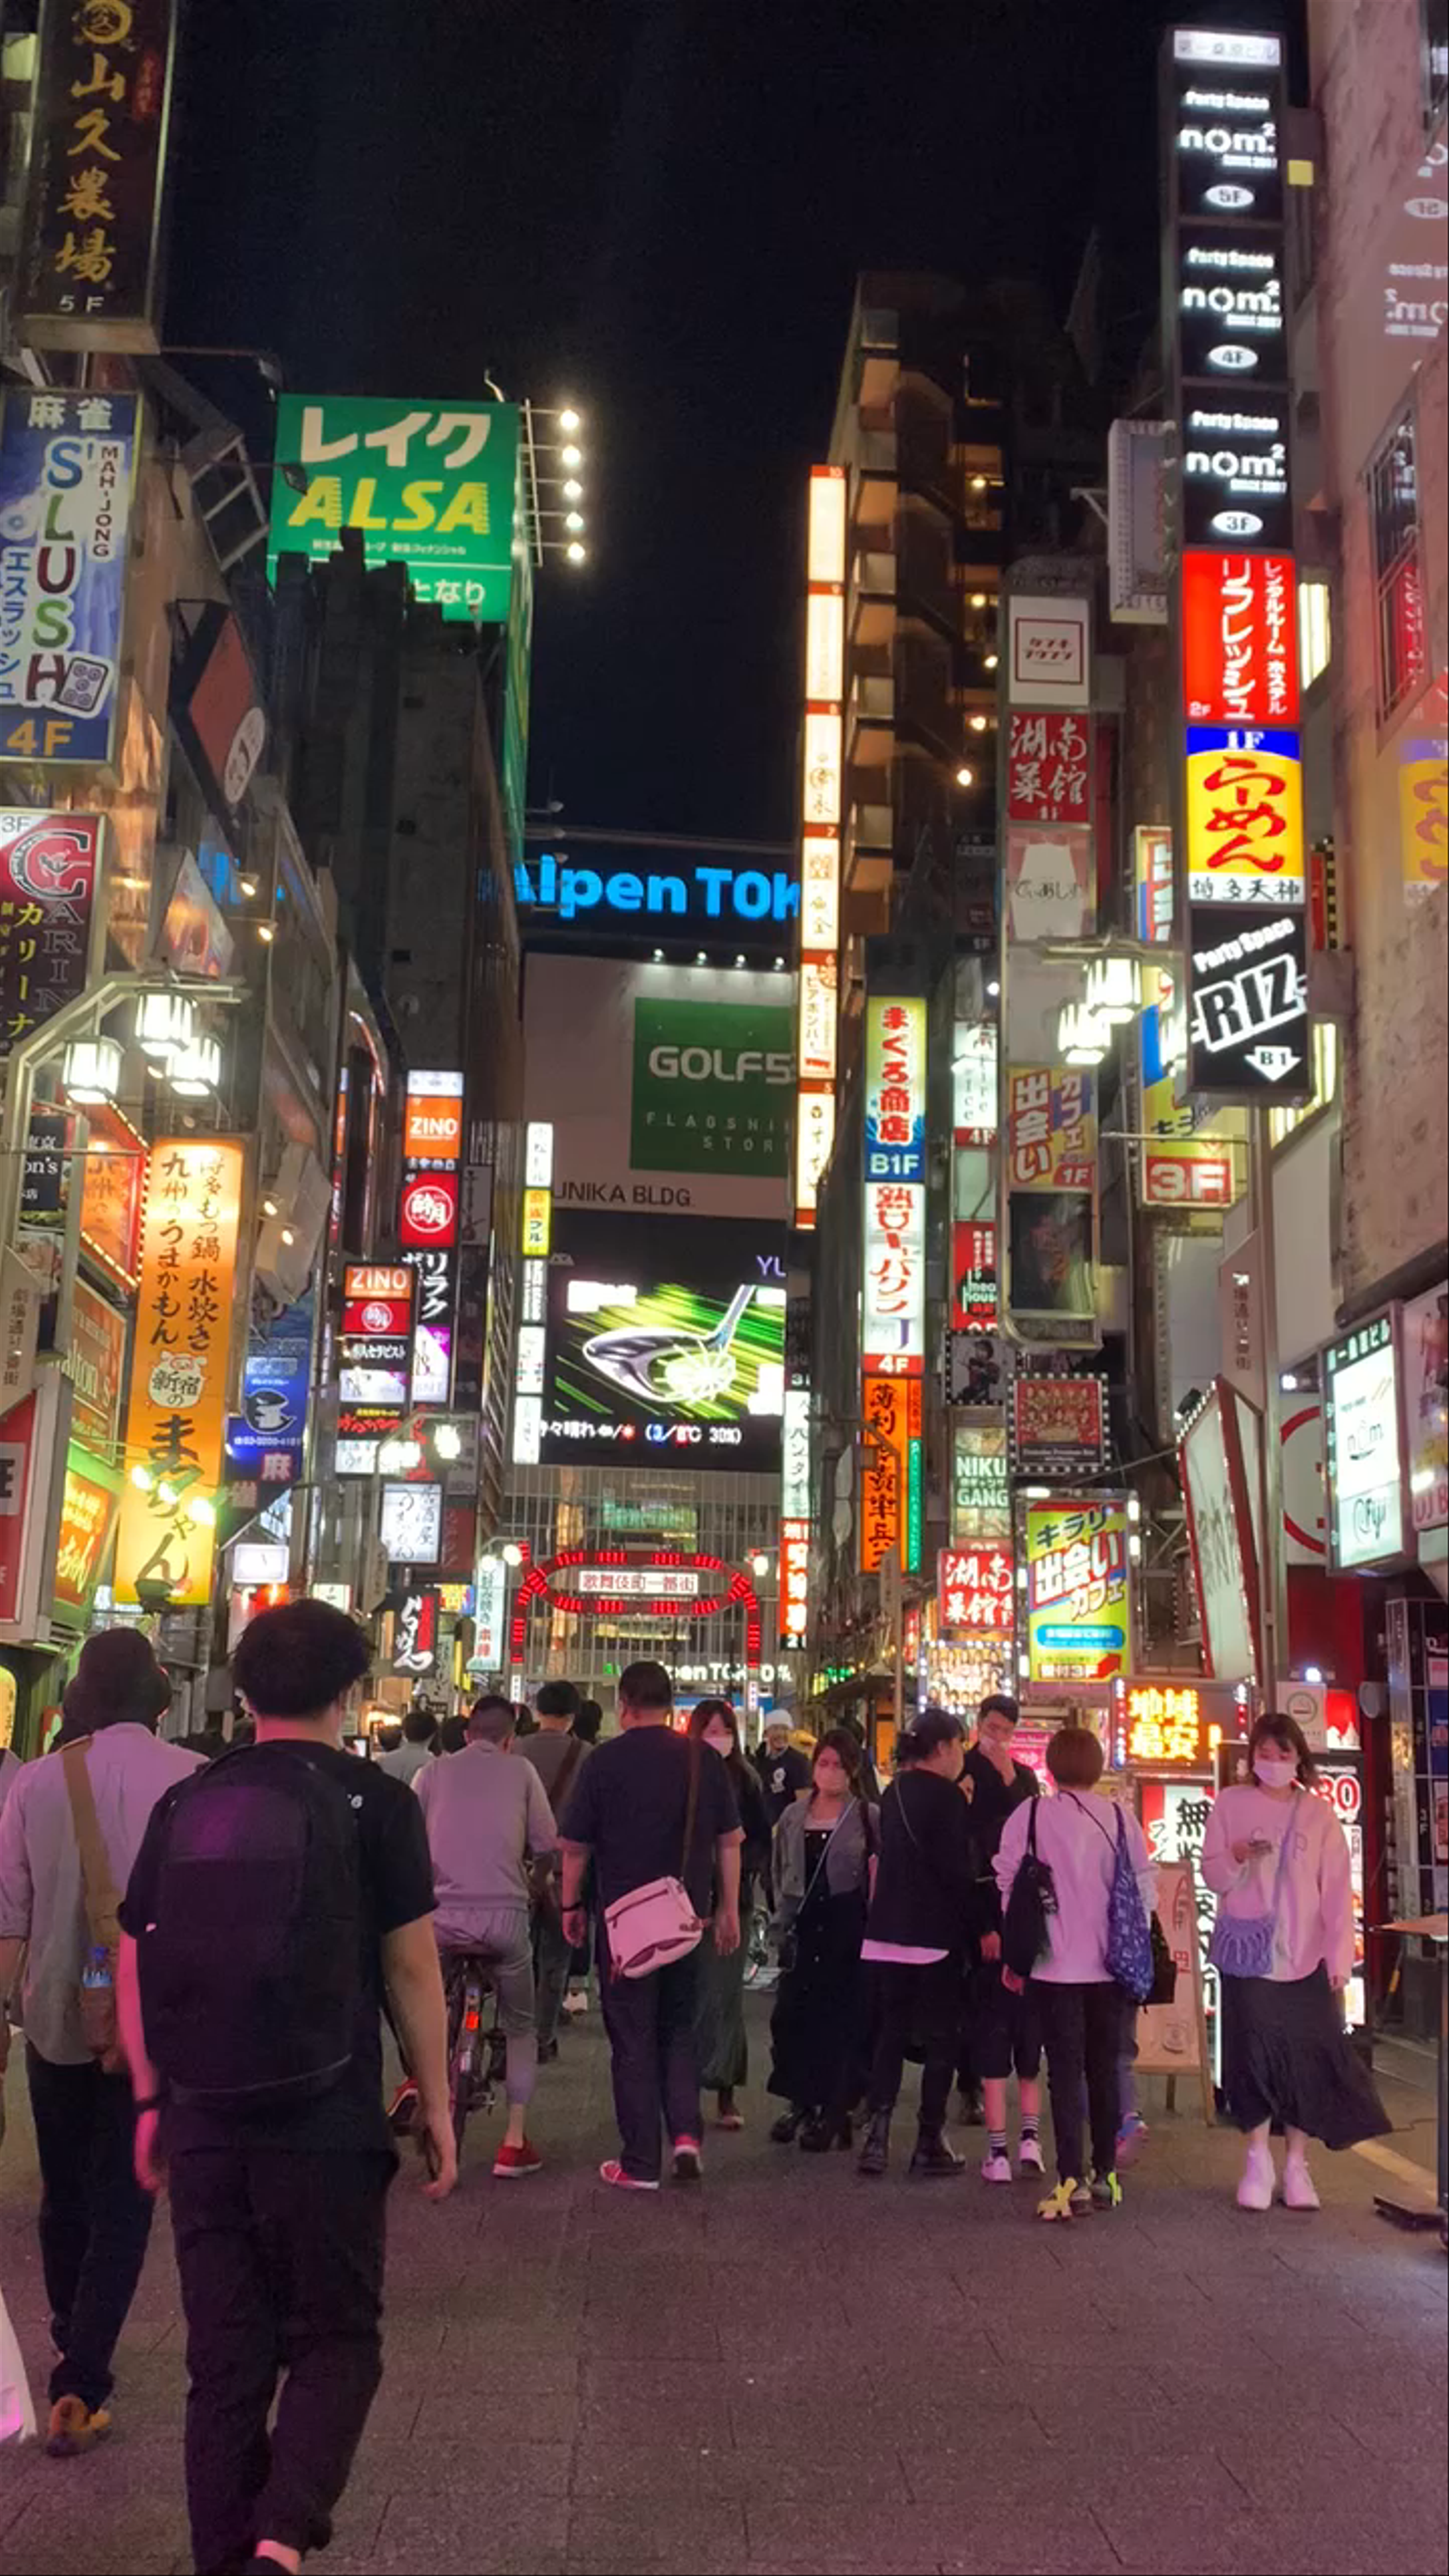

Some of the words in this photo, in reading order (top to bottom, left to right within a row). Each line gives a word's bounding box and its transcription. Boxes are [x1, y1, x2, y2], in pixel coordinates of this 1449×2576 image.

[55, 53, 126, 283] 山久農場
[1220, 190, 1241, 203] 5F
[60, 295, 104, 312] 5F
[1223, 349, 1243, 364] 4F
[28, 396, 113, 431] 麻雀
[300, 407, 491, 469] レイク
[288, 477, 491, 534] ALSA
[1226, 516, 1249, 531] 3F
[1221, 557, 1256, 720] リフレッシュ
[7, 720, 73, 756] 4F
[1010, 716, 1087, 762] 湖南
[1227, 731, 1264, 749] 1F
[2, 816, 31, 832] 3F
[1193, 877, 1300, 902] 博多天神
[1193, 933, 1243, 973] Party
[1238, 917, 1296, 954] Space
[8, 902, 44, 1038] カリーナ
[1199, 958, 1299, 1045] RIZ
[1260, 1052, 1287, 1065] B1
[410, 1117, 458, 1135] ZINO
[1015, 1070, 1052, 1181] 出会い
[1060, 1075, 1086, 1152] カフェ
[703, 1137, 789, 1153] STOR
[870, 1153, 920, 1175] B1F
[1062, 1167, 1089, 1184] 1F
[1150, 1162, 1227, 1200] 3F
[351, 1269, 408, 1290] ZINO
[878, 1357, 910, 1373] 4F
[152, 1370, 200, 1395] 新宿
[167, 1394, 184, 1406] の
[956, 1457, 1007, 1478] NIKU
[957, 1488, 1009, 1507] GANG
[1037, 1506, 1107, 1548] キラリ
[945, 1553, 1013, 1592] 湖南
[1035, 1533, 1120, 1604] 出会い
[582, 1573, 695, 1593] 歌舞伎町一番街
[1071, 1578, 1125, 1622] カフェ
